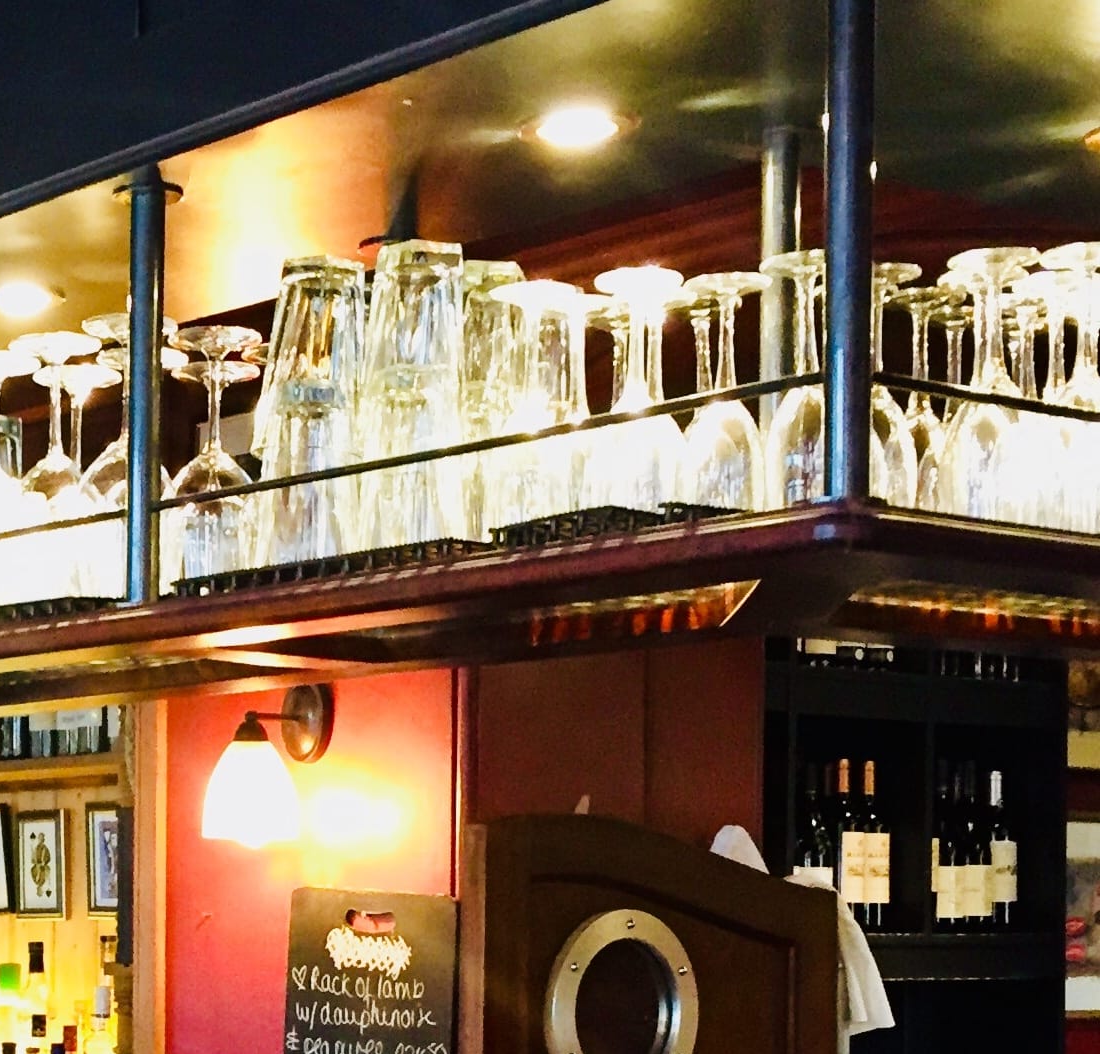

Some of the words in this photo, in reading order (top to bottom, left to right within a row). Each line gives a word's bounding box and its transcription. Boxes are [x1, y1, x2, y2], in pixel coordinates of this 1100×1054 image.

[311, 965, 353, 998] Rack
[355, 977, 373, 1008] of
[377, 974, 425, 1000] lamb
